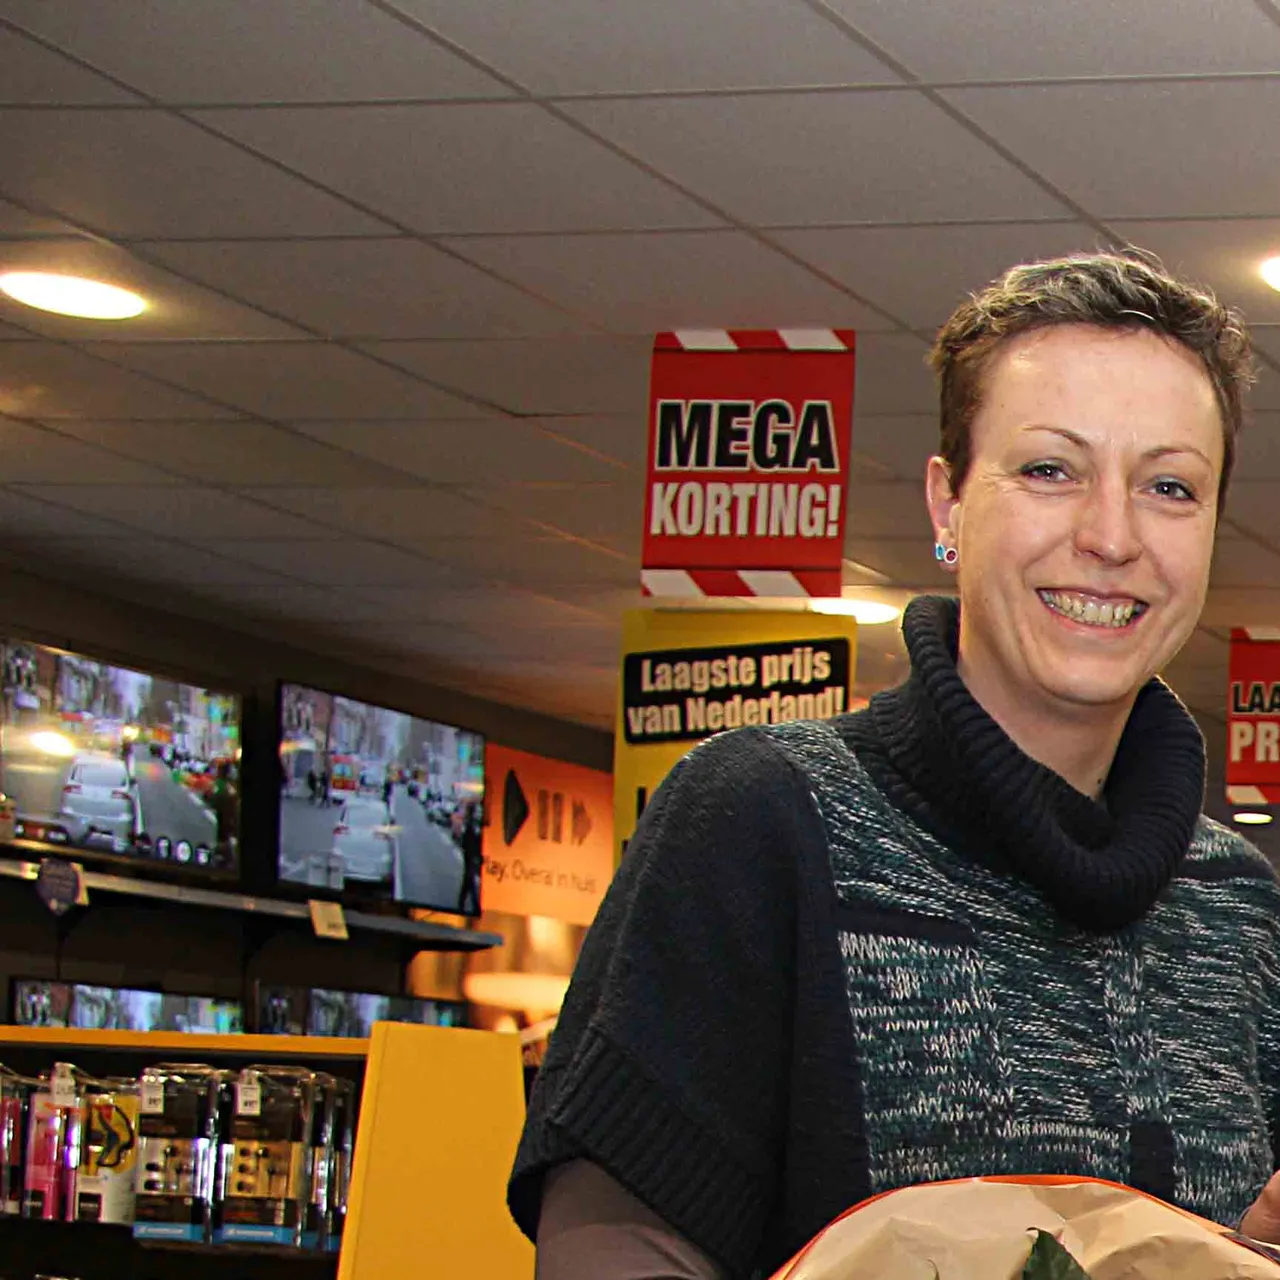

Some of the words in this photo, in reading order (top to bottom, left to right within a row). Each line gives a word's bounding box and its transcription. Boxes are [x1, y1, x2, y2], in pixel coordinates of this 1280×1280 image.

[654, 399, 840, 473] MEGA
[651, 482, 841, 537] KORTING!
[641, 656, 757, 693] Laagste
[761, 647, 831, 688] prijs
[627, 703, 682, 736] van
[685, 685, 845, 732] Nederland!
